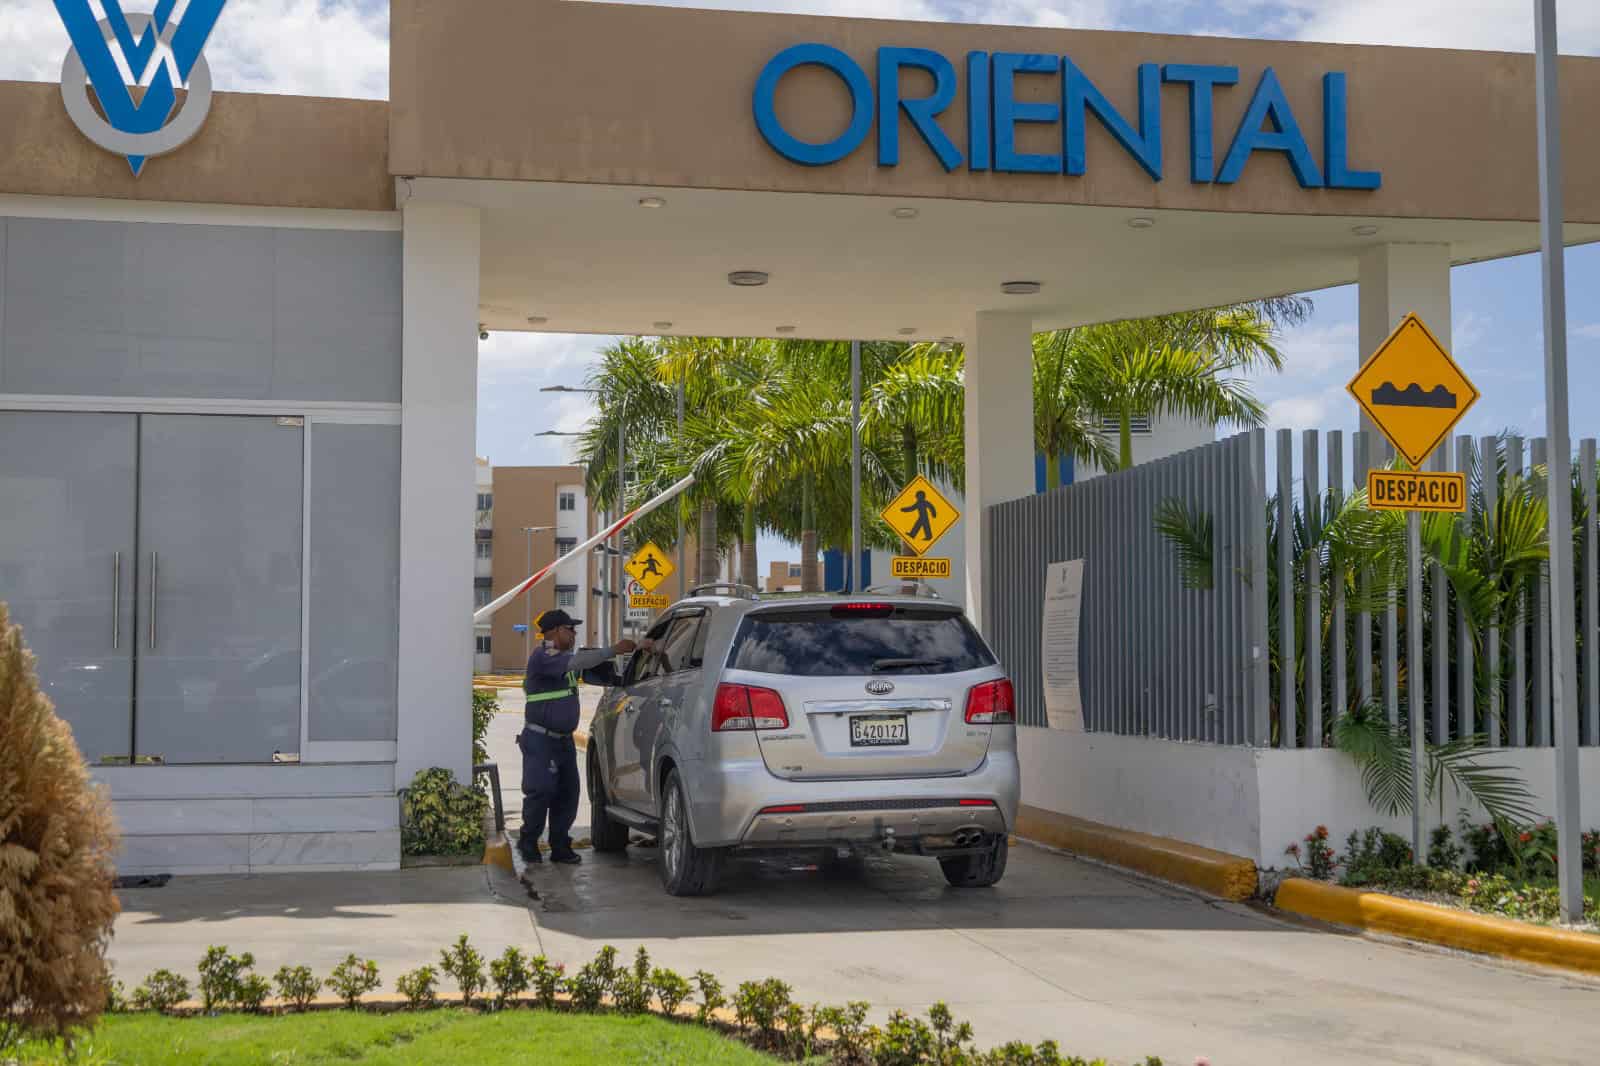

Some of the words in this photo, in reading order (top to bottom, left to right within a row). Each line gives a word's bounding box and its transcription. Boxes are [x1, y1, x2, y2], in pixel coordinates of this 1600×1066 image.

[751, 42, 1381, 190] ORIENTAL
[1375, 478, 1458, 503] DESPACIO
[895, 561, 947, 574] DESPACIO
[854, 724, 905, 739] G420127
